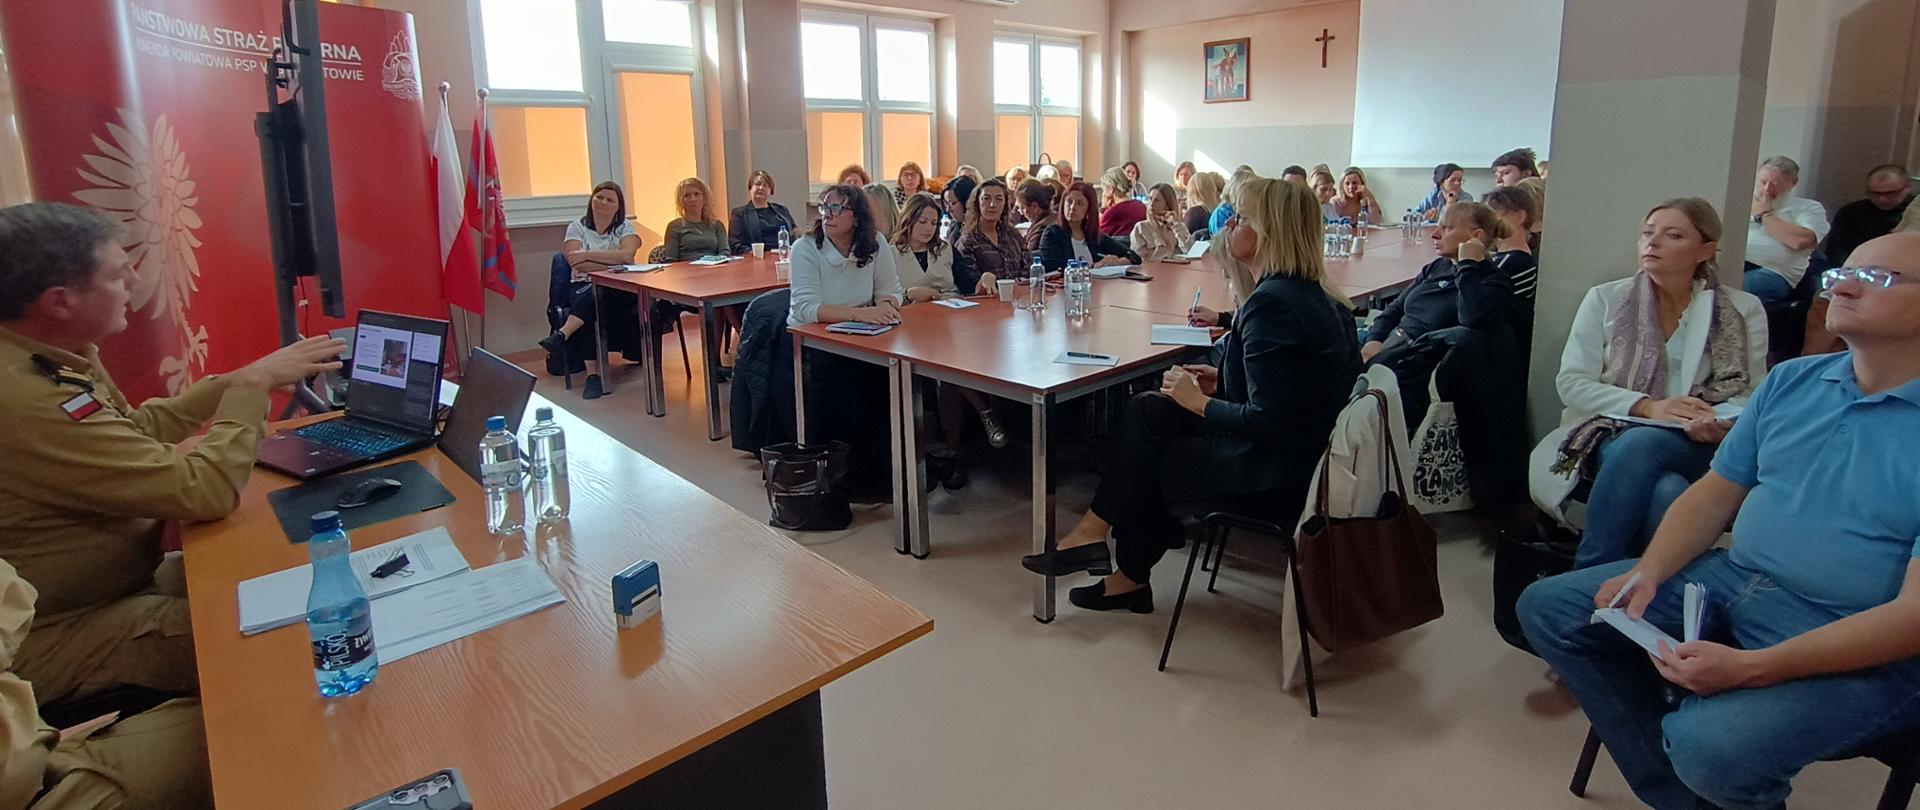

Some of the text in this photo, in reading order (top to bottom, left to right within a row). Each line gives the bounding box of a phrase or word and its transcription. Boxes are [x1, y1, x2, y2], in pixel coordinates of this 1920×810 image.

[171, 46, 233, 70] POWIATOWA
[235, 58, 257, 73] PSP
[213, 27, 270, 52] STRAŻ
[272, 36, 362, 61] PRNA
[326, 632, 352, 667] PILSKO
